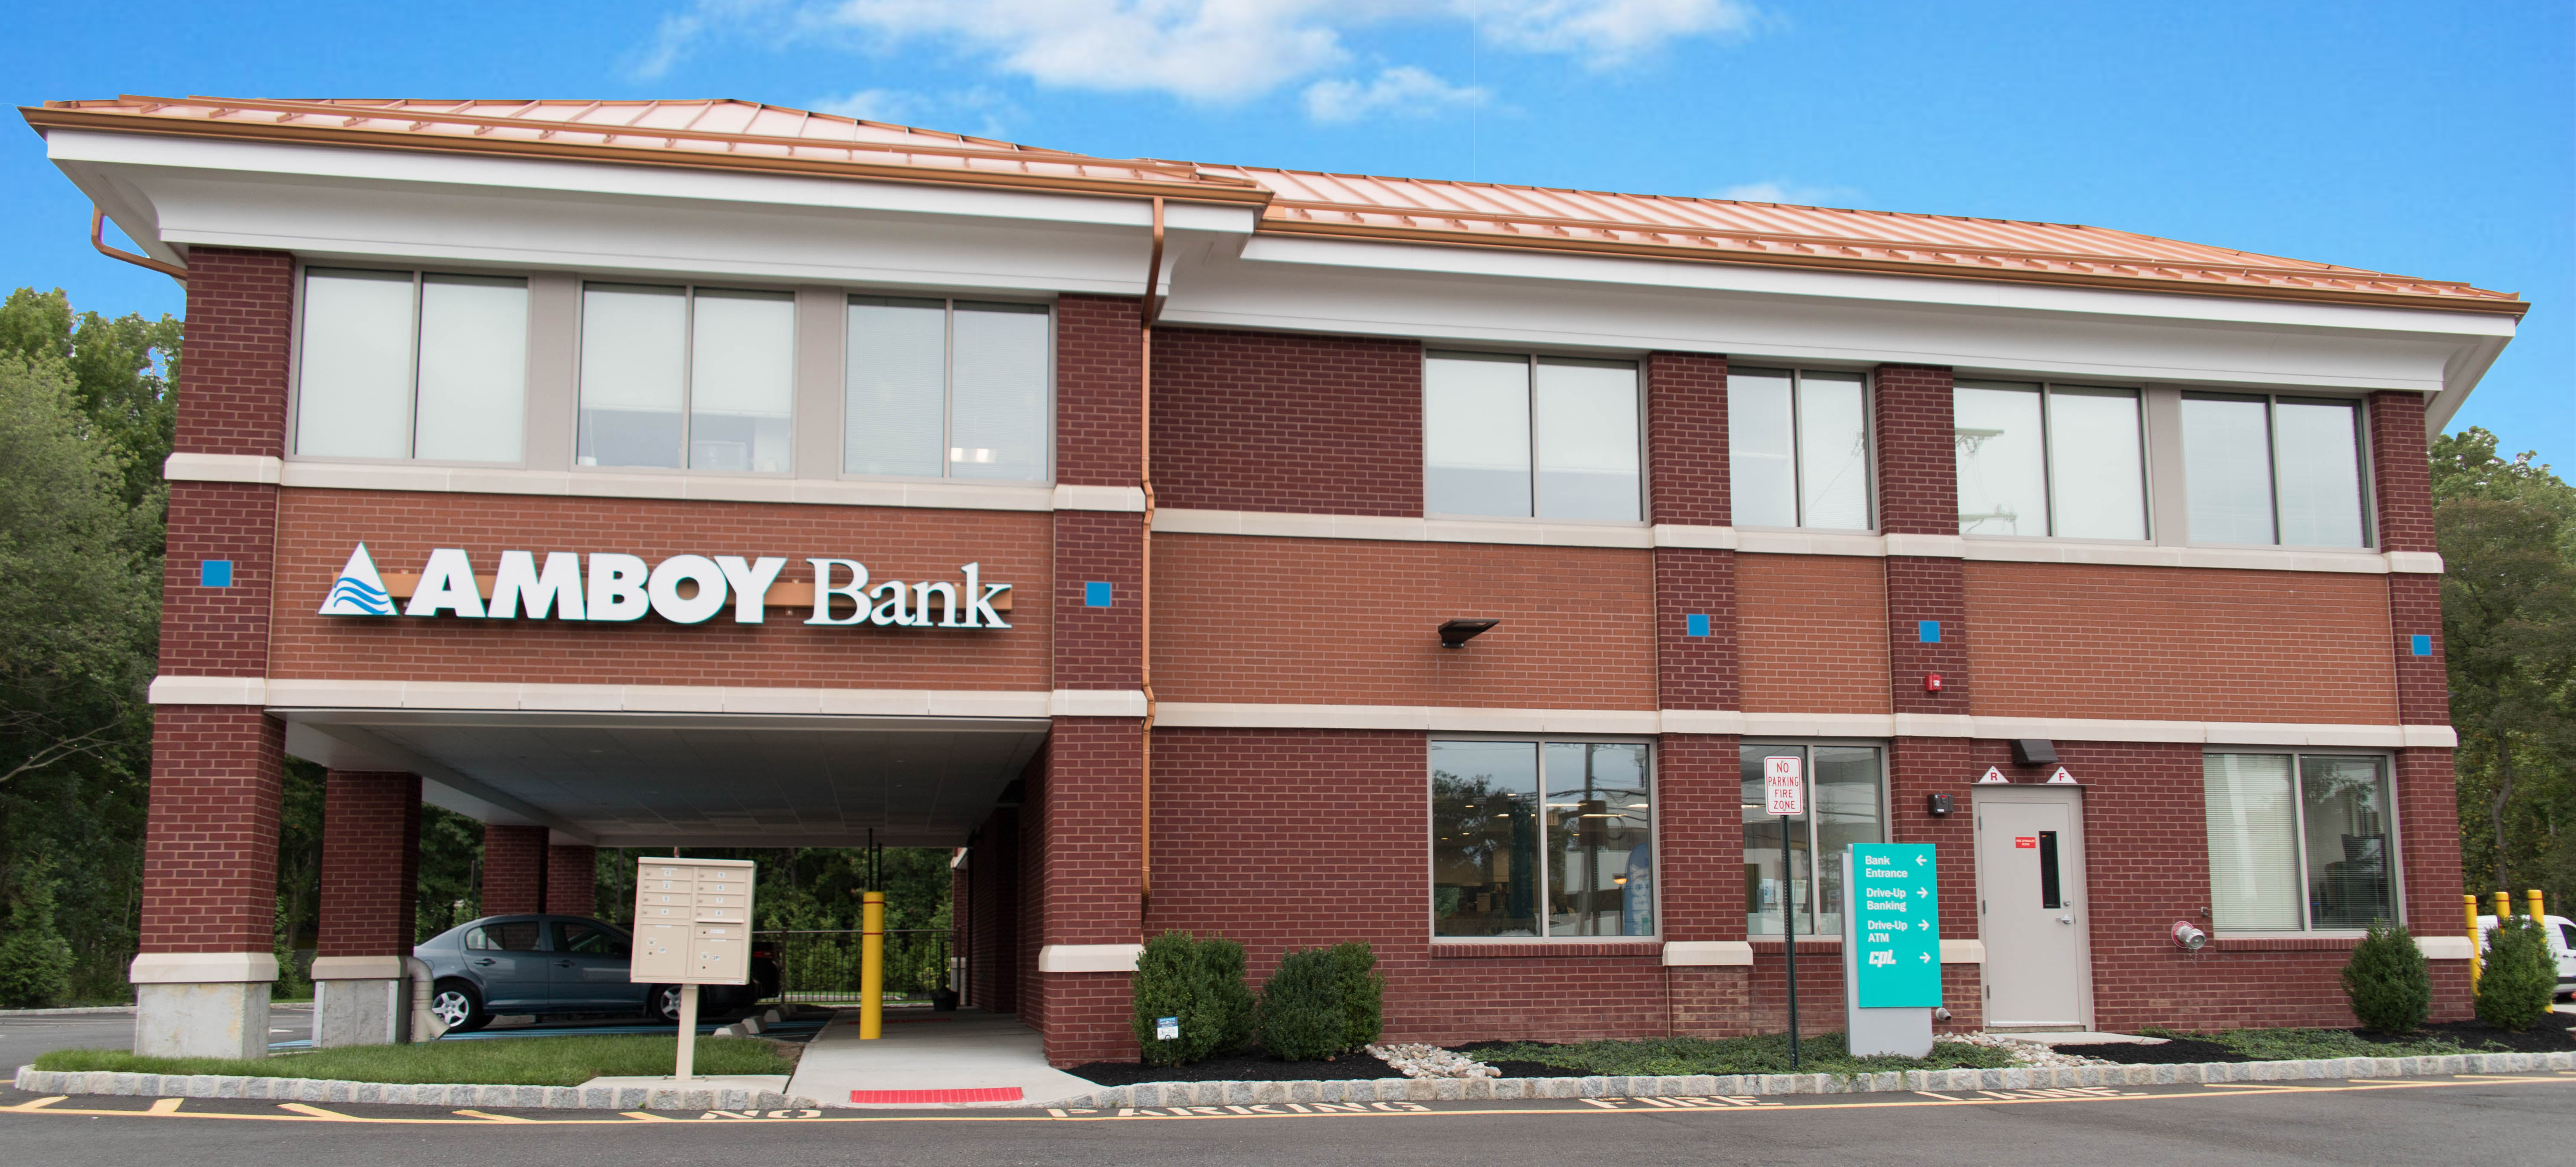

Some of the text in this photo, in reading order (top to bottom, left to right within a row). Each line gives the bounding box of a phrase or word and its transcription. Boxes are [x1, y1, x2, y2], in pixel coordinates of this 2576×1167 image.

[405, 548, 1012, 628] AMBOY Bank
[1776, 762, 1789, 773] NO
[1768, 776, 1799, 787] PARKING
[1990, 772, 1998, 781] R
[2059, 773, 2065, 781] F
[1775, 789, 1793, 798] FIRE
[1774, 801, 1795, 809] ZONE
[1865, 855, 1890, 865] Bank
[1865, 868, 1908, 878] Entrance
[1866, 887, 1906, 899] Drive-Up
[1629, 865, 1649, 936] MBOY
[1867, 900, 1907, 912] Banking
[1867, 920, 1908, 931] Drive-Up
[1868, 933, 1889, 942] ATM
[700, 1086, 2149, 1119] NO PARKING FIRE LANE
